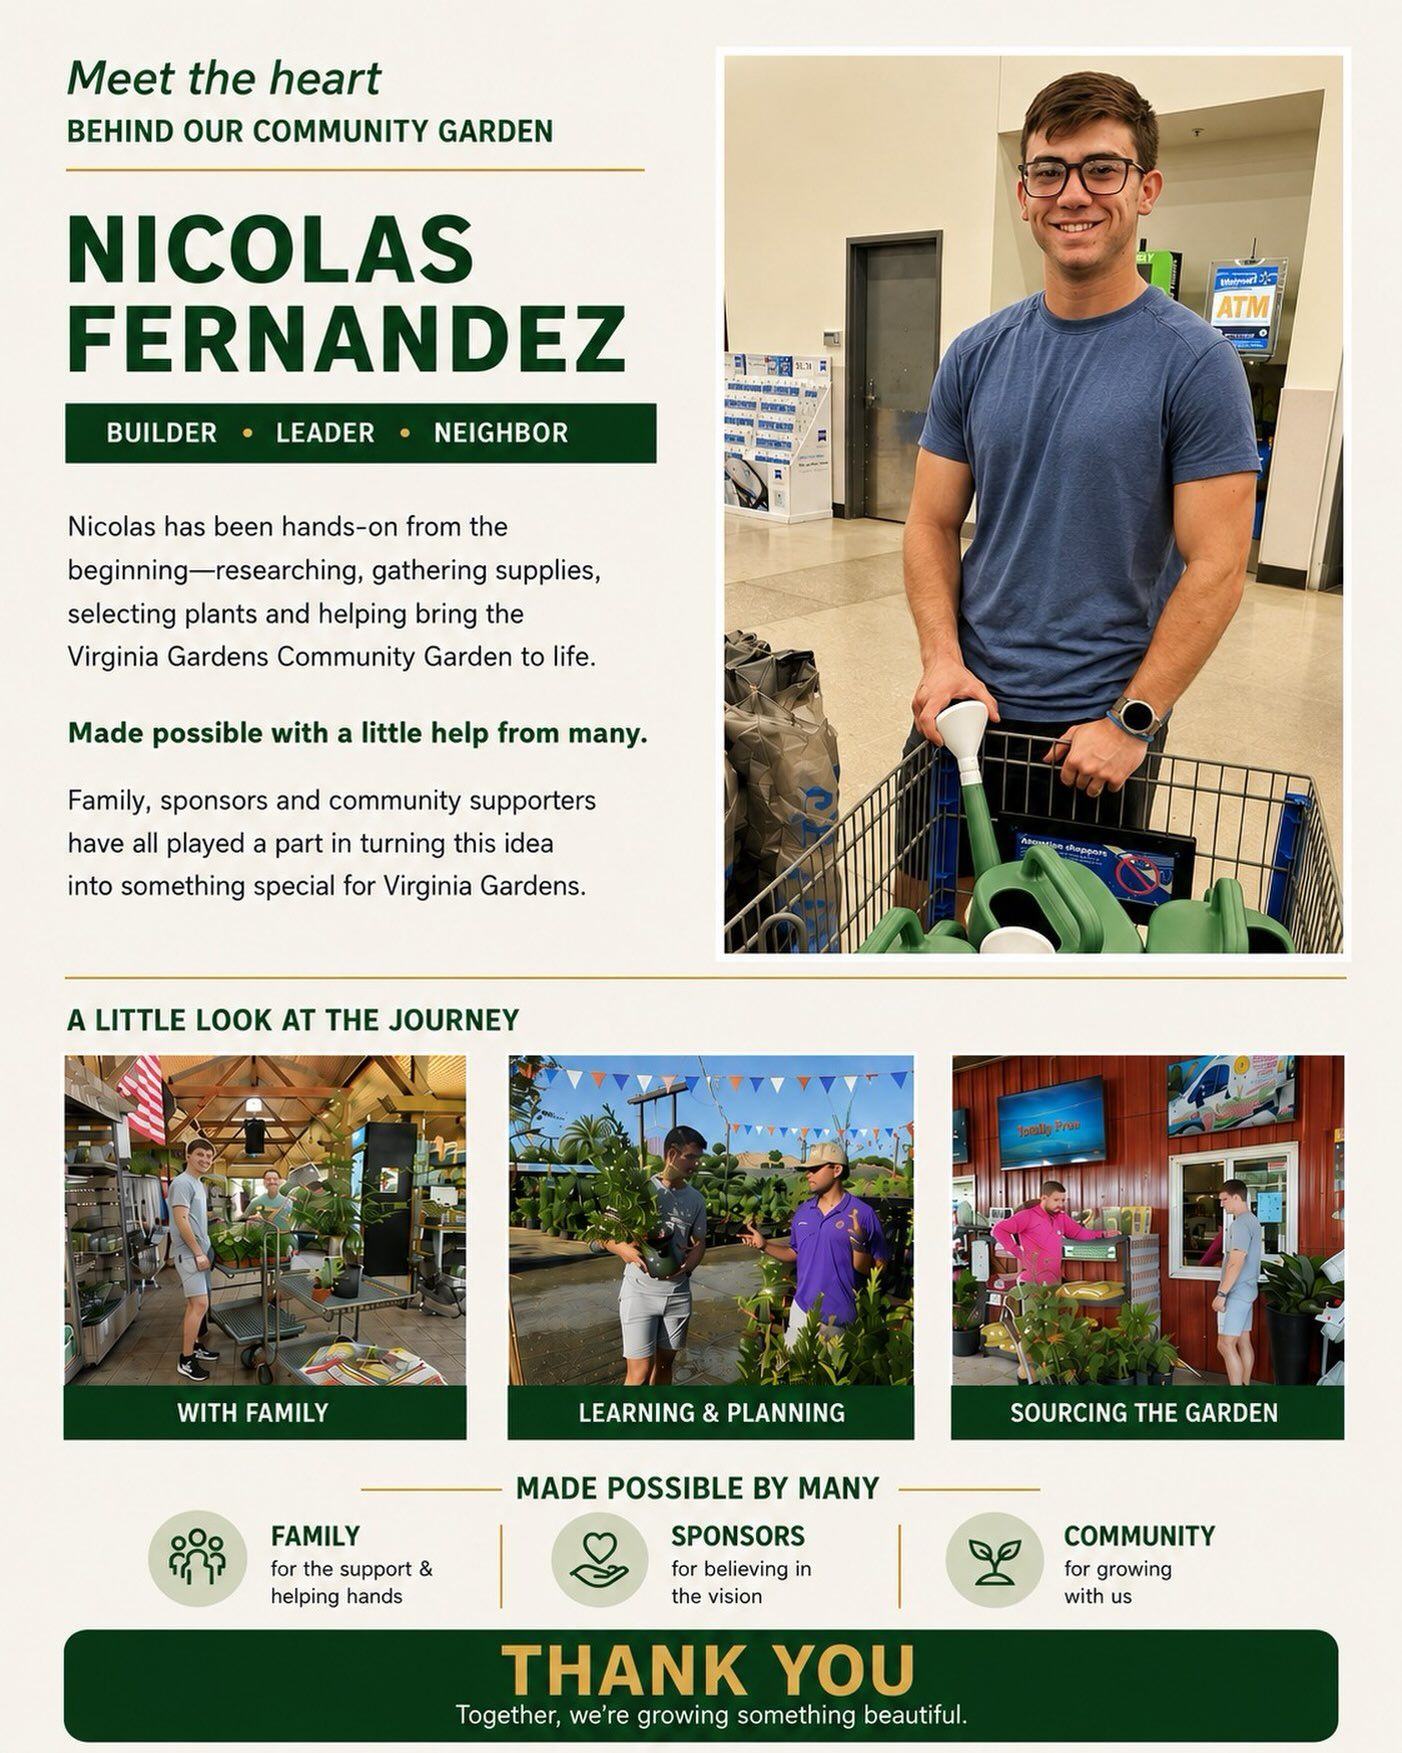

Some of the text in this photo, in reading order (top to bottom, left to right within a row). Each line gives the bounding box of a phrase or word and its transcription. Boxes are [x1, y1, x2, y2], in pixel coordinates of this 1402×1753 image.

[66, 58, 383, 96] Meet the heart
[67, 118, 553, 144] BEHIND OUR COMMUNITY GARDEN
[68, 213, 473, 285] NICOLAS
[1217, 295, 1270, 318] ATM
[68, 304, 626, 373] FERNANDEZ
[107, 421, 569, 444] BUILDER LEADER NEIGHBOR
[68, 514, 508, 537] Nicolas has been hands-on from the
[372, 557, 487, 586] gathering
[495, 557, 601, 586] supplies,
[67, 601, 525, 630] selecting plants and helping bring the
[67, 644, 596, 673] Virginia Gardens Community Garden to life.
[68, 720, 648, 750] Made possible with a little help from many.
[68, 788, 597, 816] Family, sponsors and community supporters
[68, 831, 554, 859] have all played a part in turning this idea
[68, 873, 586, 902] into something special for Virginia Gardens.
[66, 1007, 520, 1032] A LITTLE LOOK AT THE JOURNEY
[176, 1402, 329, 1423] WITH FAMILY
[579, 1402, 846, 1423] LEARNING & PLANNING
[1010, 1402, 1278, 1423] SOURCING THE GARDEN
[516, 1475, 880, 1501] MADE POSSIBLE BY MANY
[271, 1524, 361, 1547] FAMILY
[671, 1524, 806, 1547] SPONSORS
[1063, 1524, 1217, 1547] COMMUNITY
[270, 1559, 433, 1581] for the support &
[671, 1559, 812, 1582] for believing in
[1064, 1559, 1172, 1582] for growing
[271, 1586, 403, 1609] helping hands
[671, 1586, 763, 1605] the vision
[1064, 1586, 1133, 1605] with us
[500, 1643, 914, 1697] THANK YOU
[455, 1703, 967, 1730] Together, we’re growing something beautiful.
